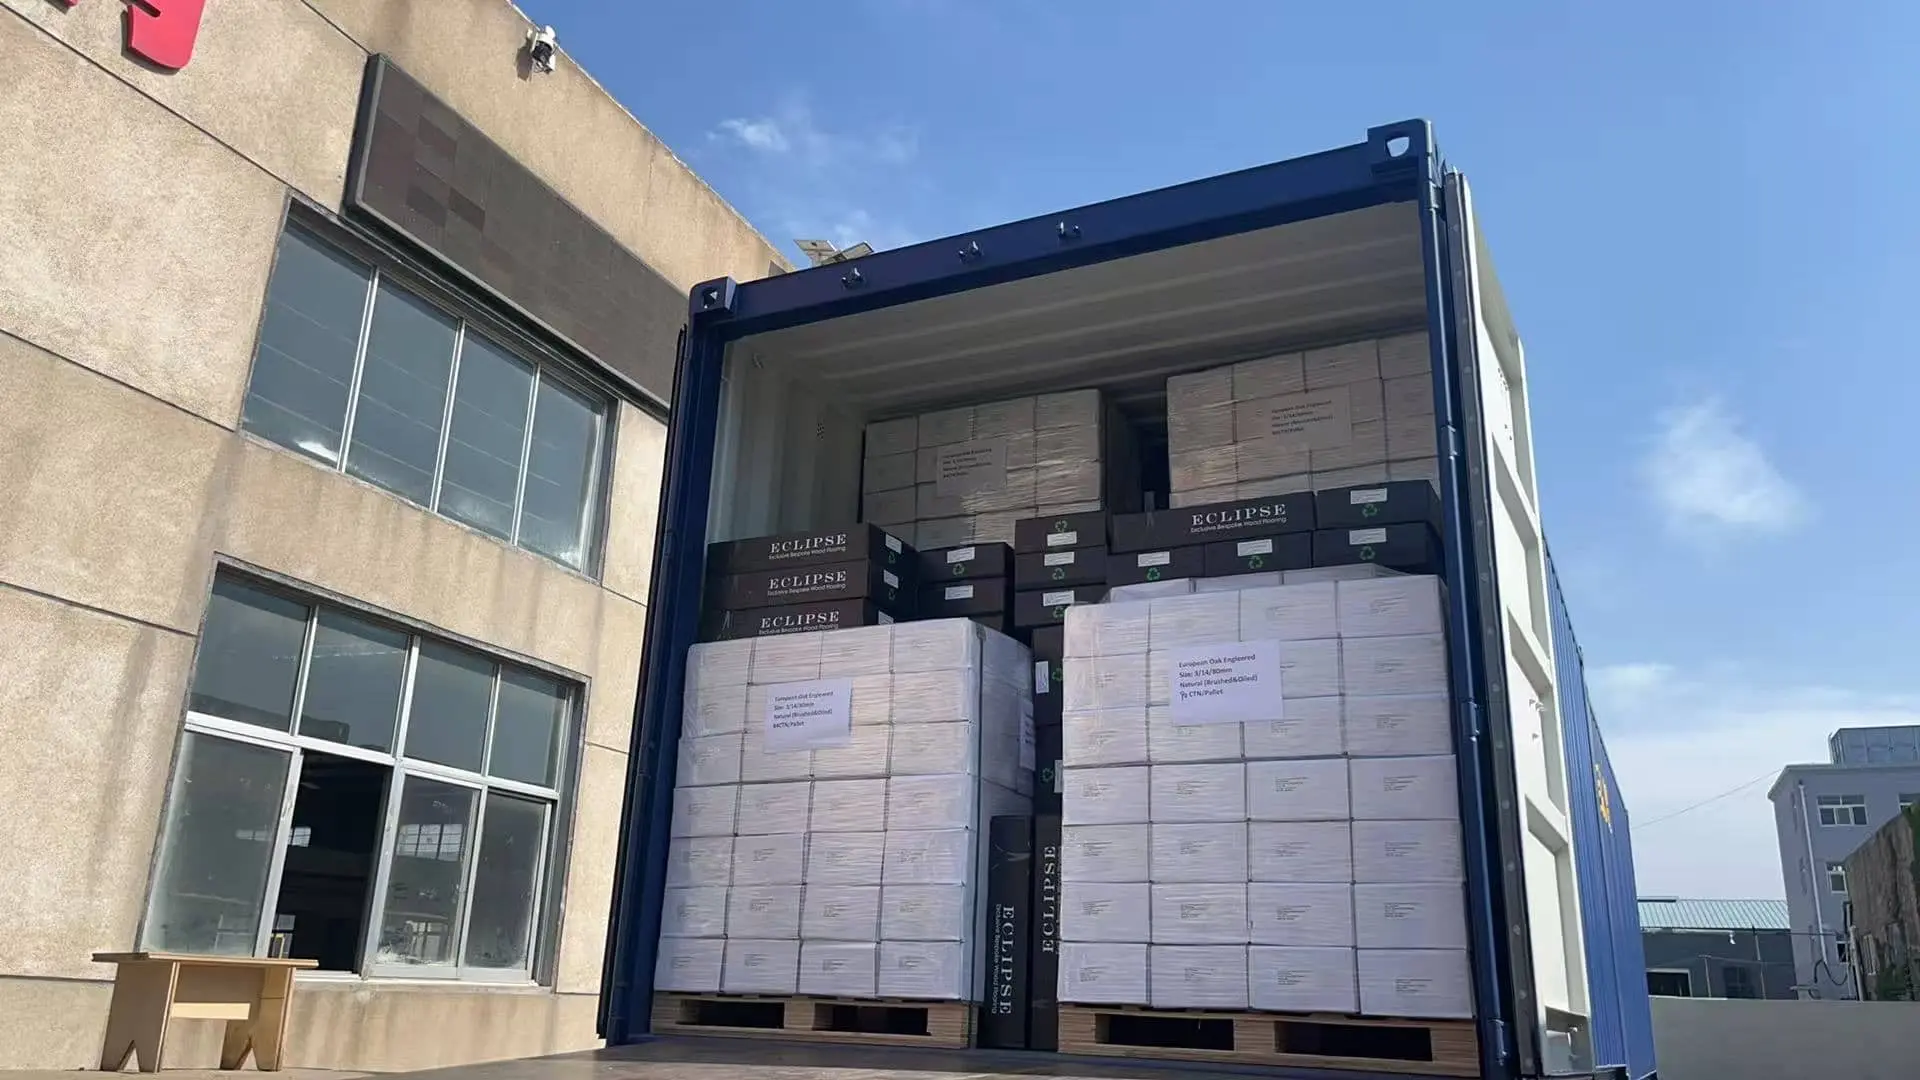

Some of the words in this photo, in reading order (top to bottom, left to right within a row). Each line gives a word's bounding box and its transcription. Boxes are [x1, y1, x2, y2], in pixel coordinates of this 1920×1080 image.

[1192, 504, 1286, 526] ECLIPSE
[771, 534, 846, 553] ECLIPSE
[769, 571, 846, 590] ECLIPSE
[761, 611, 839, 629] ECLIPSE
[1179, 660, 1208, 668] European
[1180, 680, 1203, 688] Natural
[1042, 846, 1056, 953] ECLIPSE
[1000, 906, 1014, 1014] ECLIPSE
